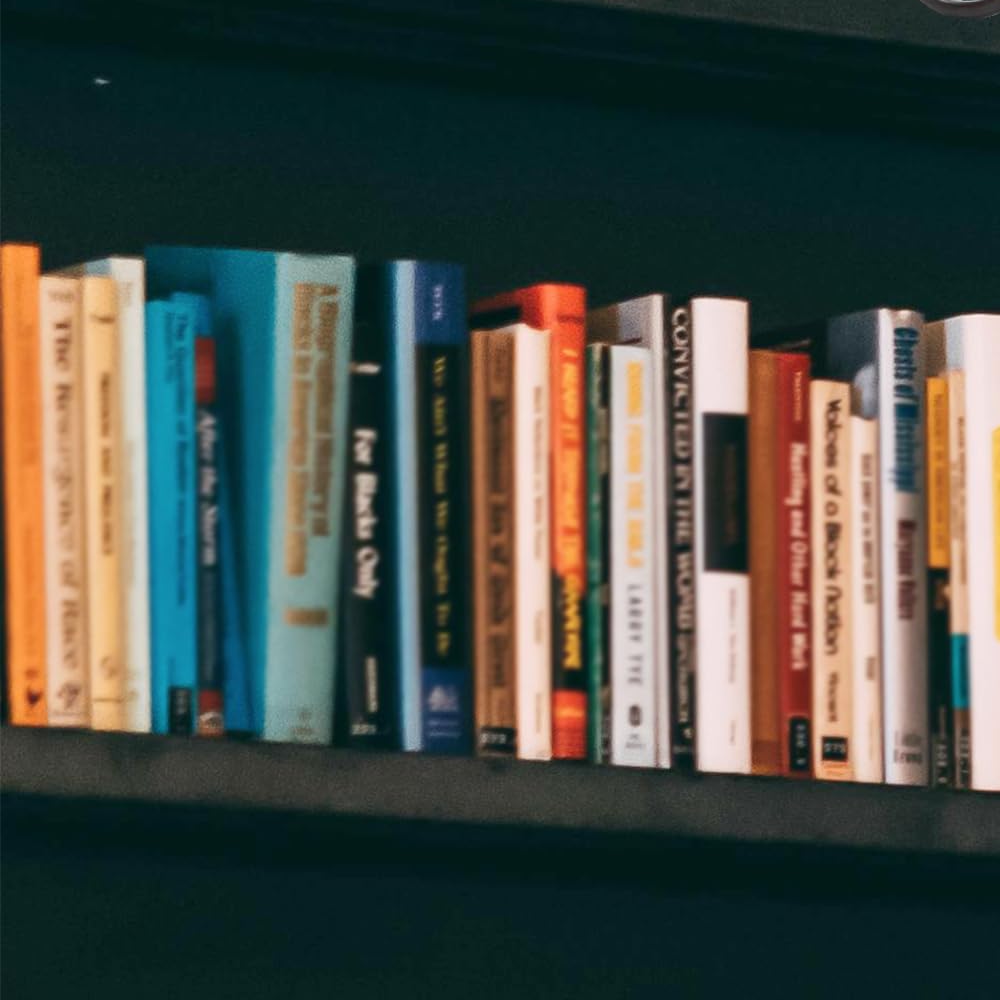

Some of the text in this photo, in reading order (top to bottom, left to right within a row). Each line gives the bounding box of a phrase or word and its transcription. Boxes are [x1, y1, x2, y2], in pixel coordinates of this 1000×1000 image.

[55, 317, 81, 366] The
[434, 356, 449, 387] We
[824, 399, 844, 463] Voices
[890, 326, 920, 494] Ghosts of Mississippi
[200, 408, 218, 566] After the Storm
[434, 443, 449, 493] What
[673, 306, 696, 630] CONVICTED IN THE WOMB
[824, 470, 844, 495] of
[353, 428, 378, 599] For Blacks Only
[791, 509, 809, 538] and
[57, 561, 82, 591] of
[791, 541, 809, 586] Other
[824, 522, 844, 581] Black
[58, 598, 82, 669] Race
[434, 602, 449, 625] To
[626, 583, 645, 686] LARRY TYE
[791, 591, 809, 628] Hard
[824, 586, 844, 656] Nation
[791, 632, 809, 671] Work
